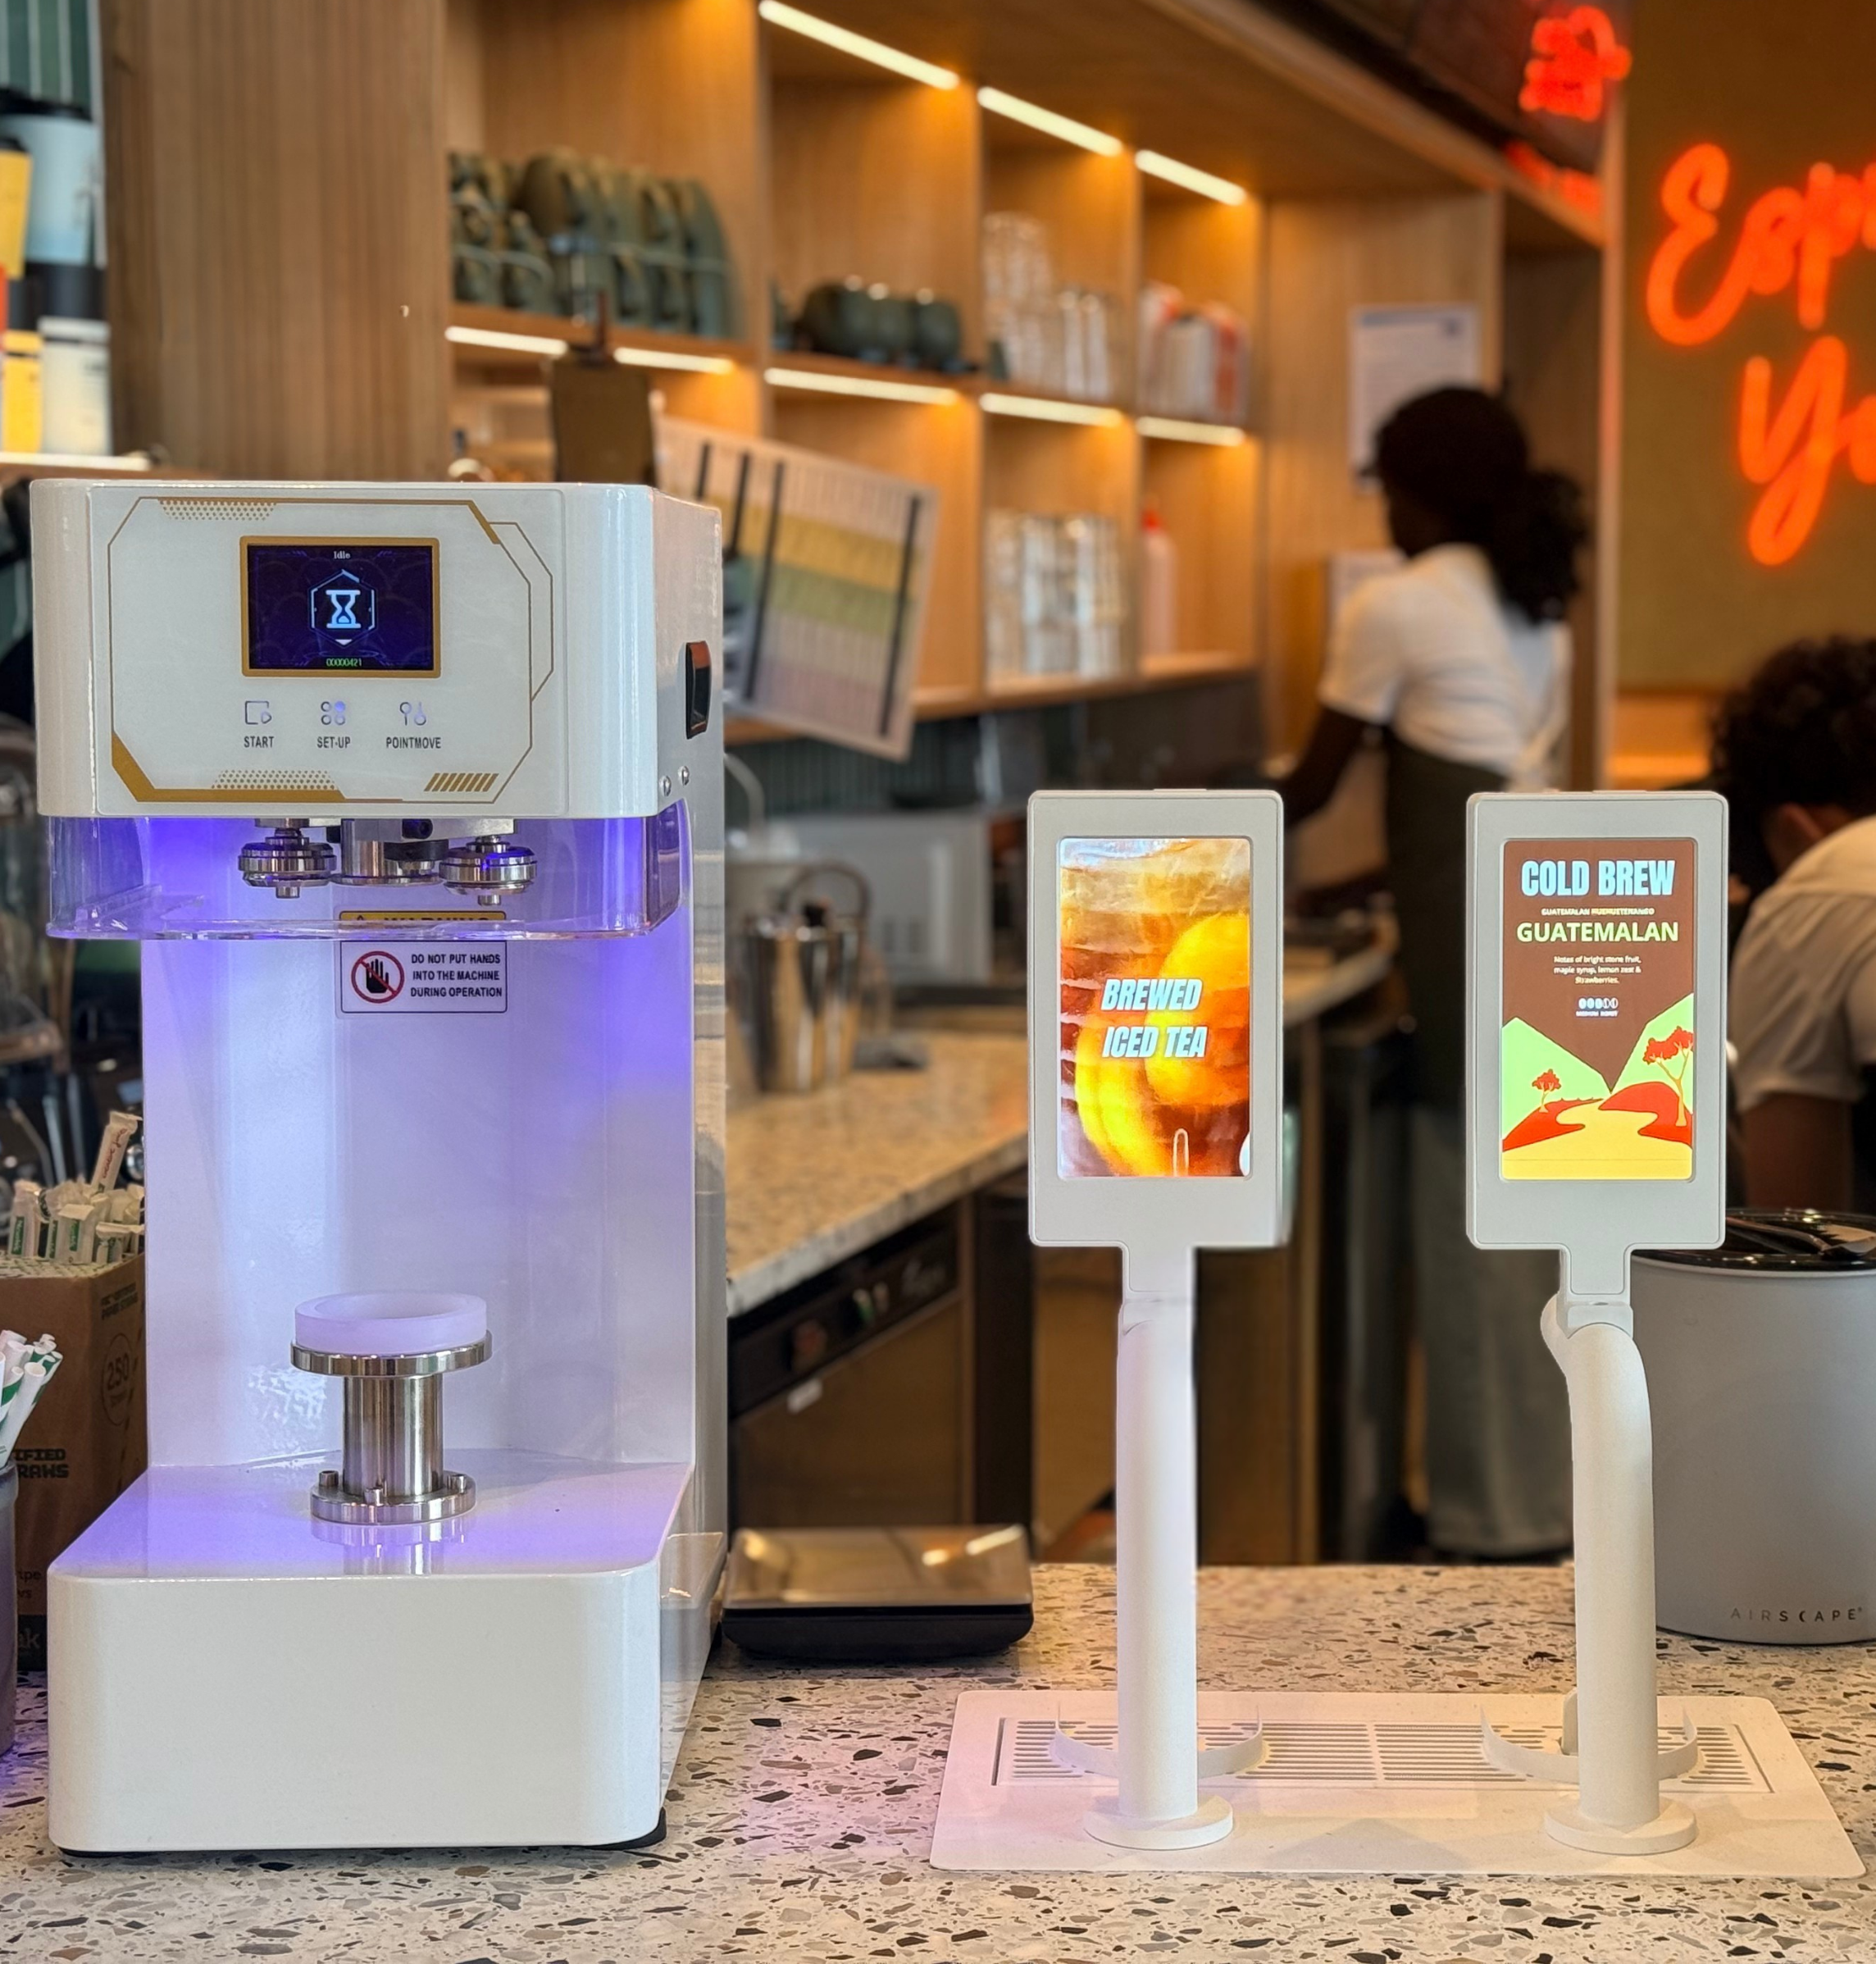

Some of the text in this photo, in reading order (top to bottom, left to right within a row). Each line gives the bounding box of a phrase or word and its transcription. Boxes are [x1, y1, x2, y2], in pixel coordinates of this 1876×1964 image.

[334, 550, 351, 559] Idle
[244, 736, 275, 749] START
[316, 736, 351, 749] SET-UP
[386, 736, 441, 749] POINTMOVE
[1521, 859, 1676, 896] COLD BREW
[1541, 908, 1590, 916] GUATEMALAN
[1517, 922, 1678, 942] GUATEMALAN
[411, 954, 501, 964] DO NOT PUT HANDS
[1583, 955, 1604, 964] bright
[412, 971, 499, 980] INTO THE MACHINE
[411, 987, 503, 997] DURING OPERATION
[1100, 978, 1203, 1010] BREWED
[1102, 1027, 1208, 1058] ICED TEA
[13, 1448, 66, 1461] IFIED
[17, 1463, 69, 1479] RAWS
